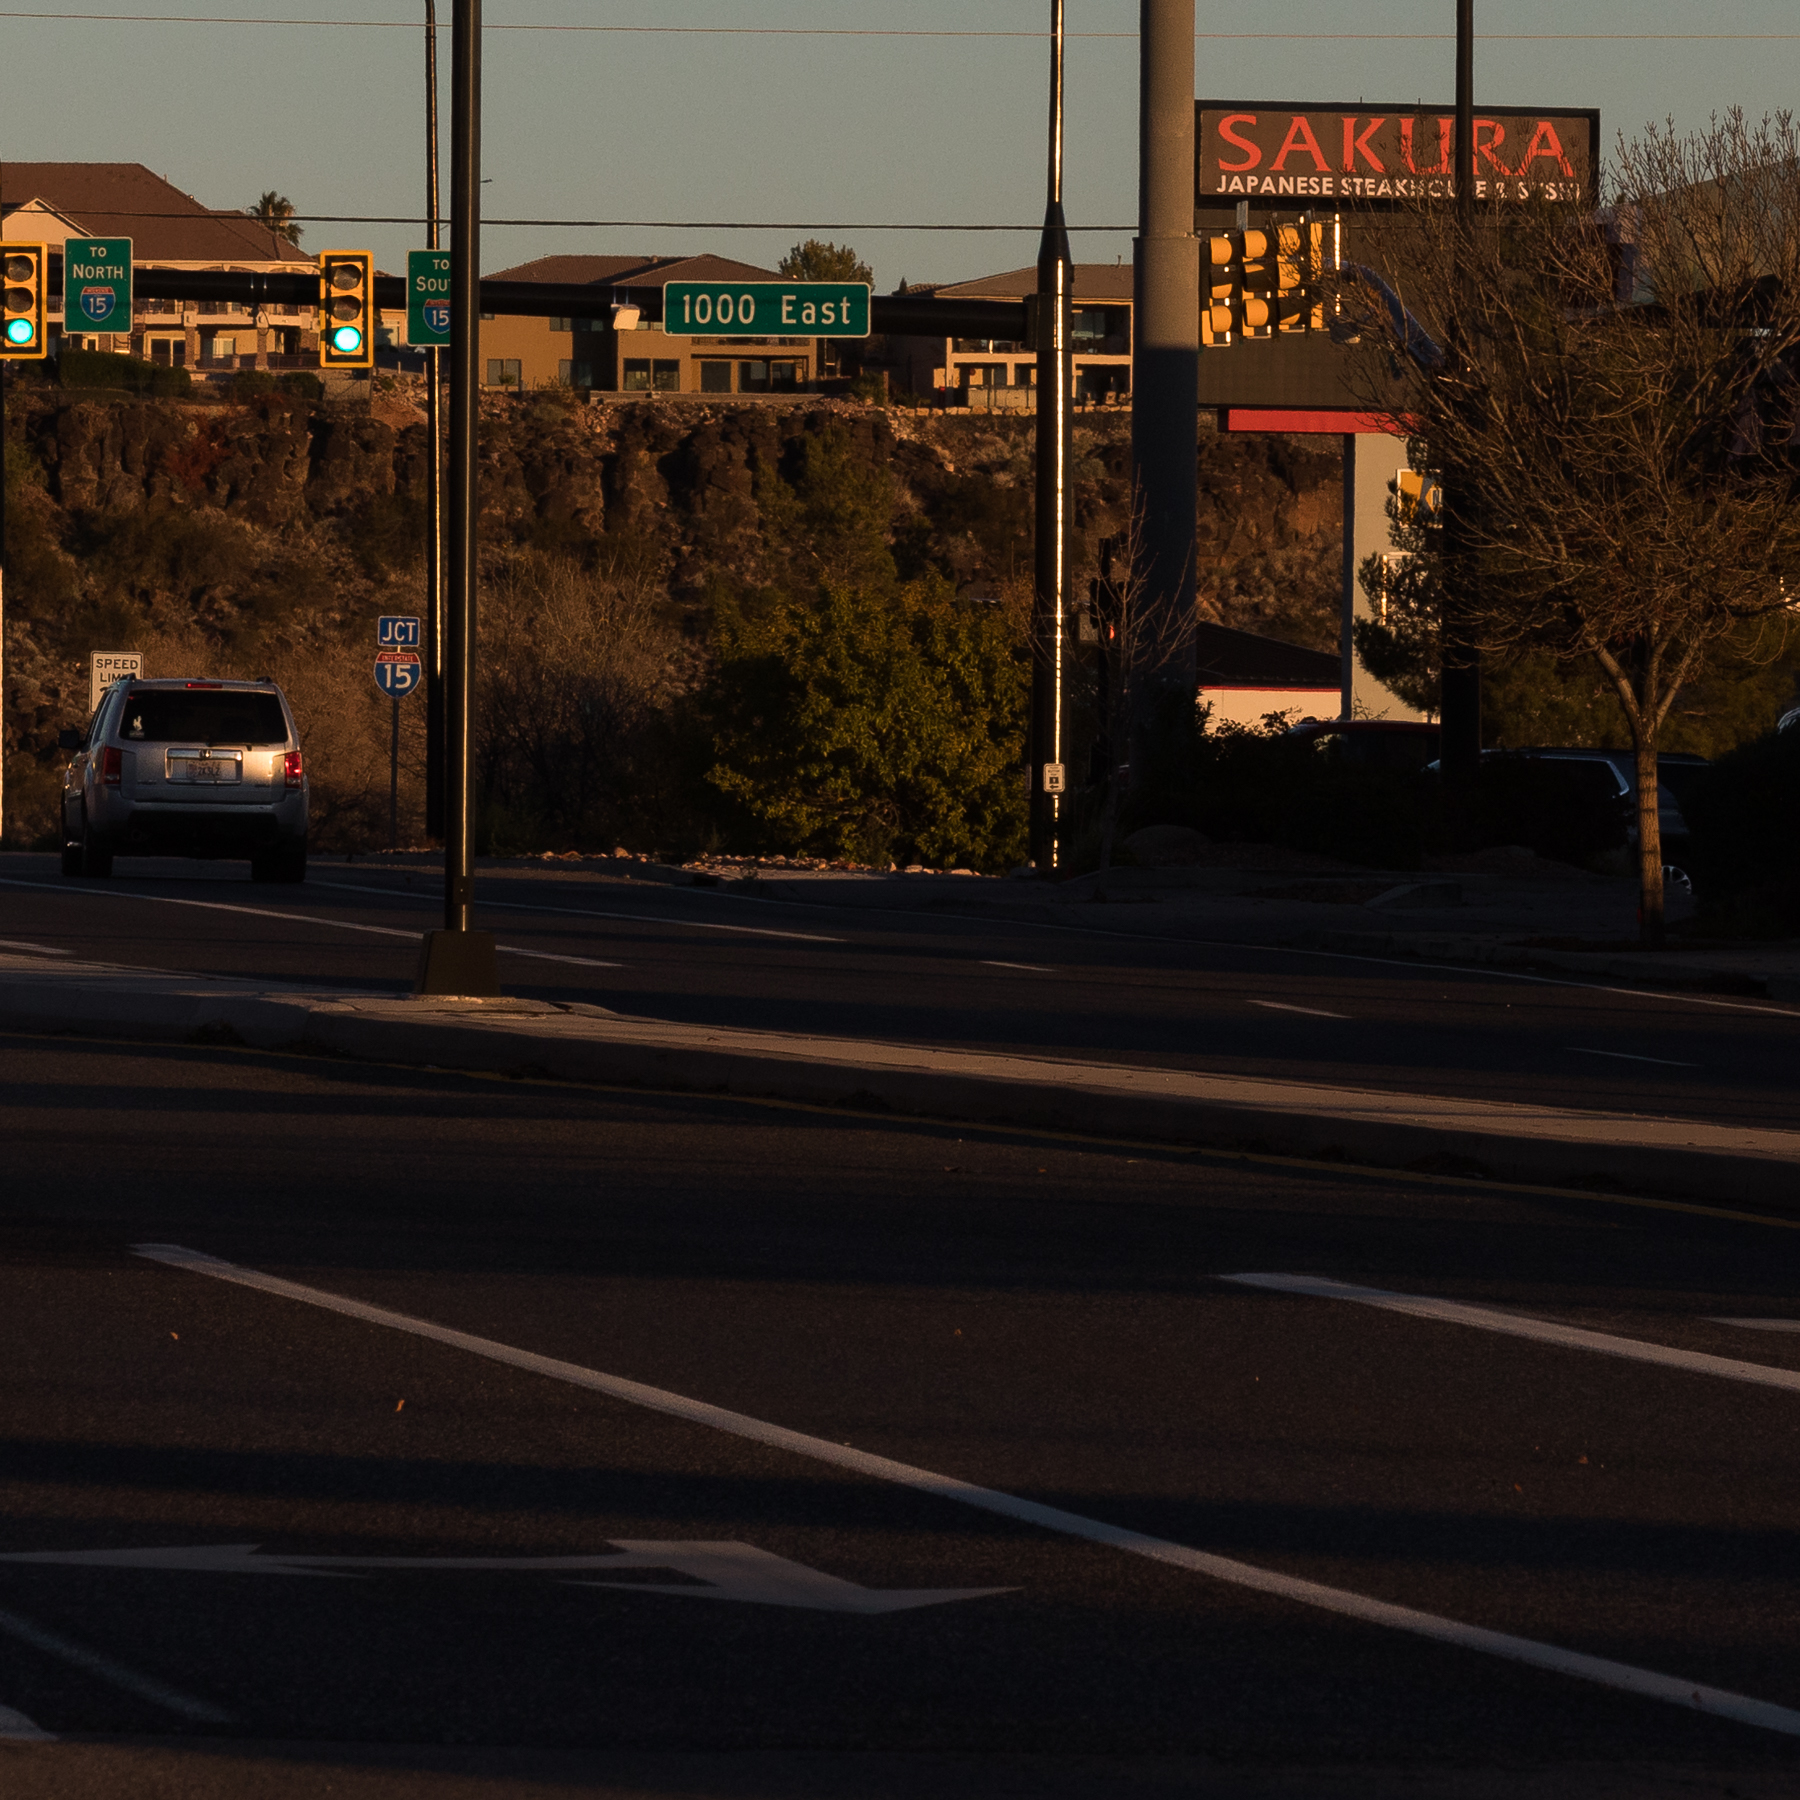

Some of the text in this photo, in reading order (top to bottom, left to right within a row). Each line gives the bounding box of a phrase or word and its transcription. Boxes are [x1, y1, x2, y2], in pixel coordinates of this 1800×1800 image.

[1217, 113, 1575, 178] SAKURA
[1215, 174, 1334, 197] JAPANESE
[89, 246, 108, 258] TO
[72, 263, 124, 280] NORTH
[432, 258, 450, 270] TO
[416, 275, 451, 292] SOU
[88, 296, 108, 314] 15
[682, 293, 852, 326] 1000 East
[432, 309, 450, 327] 15
[382, 621, 417, 642] JCT
[96, 658, 139, 670] SPEED
[384, 664, 412, 689] 15
